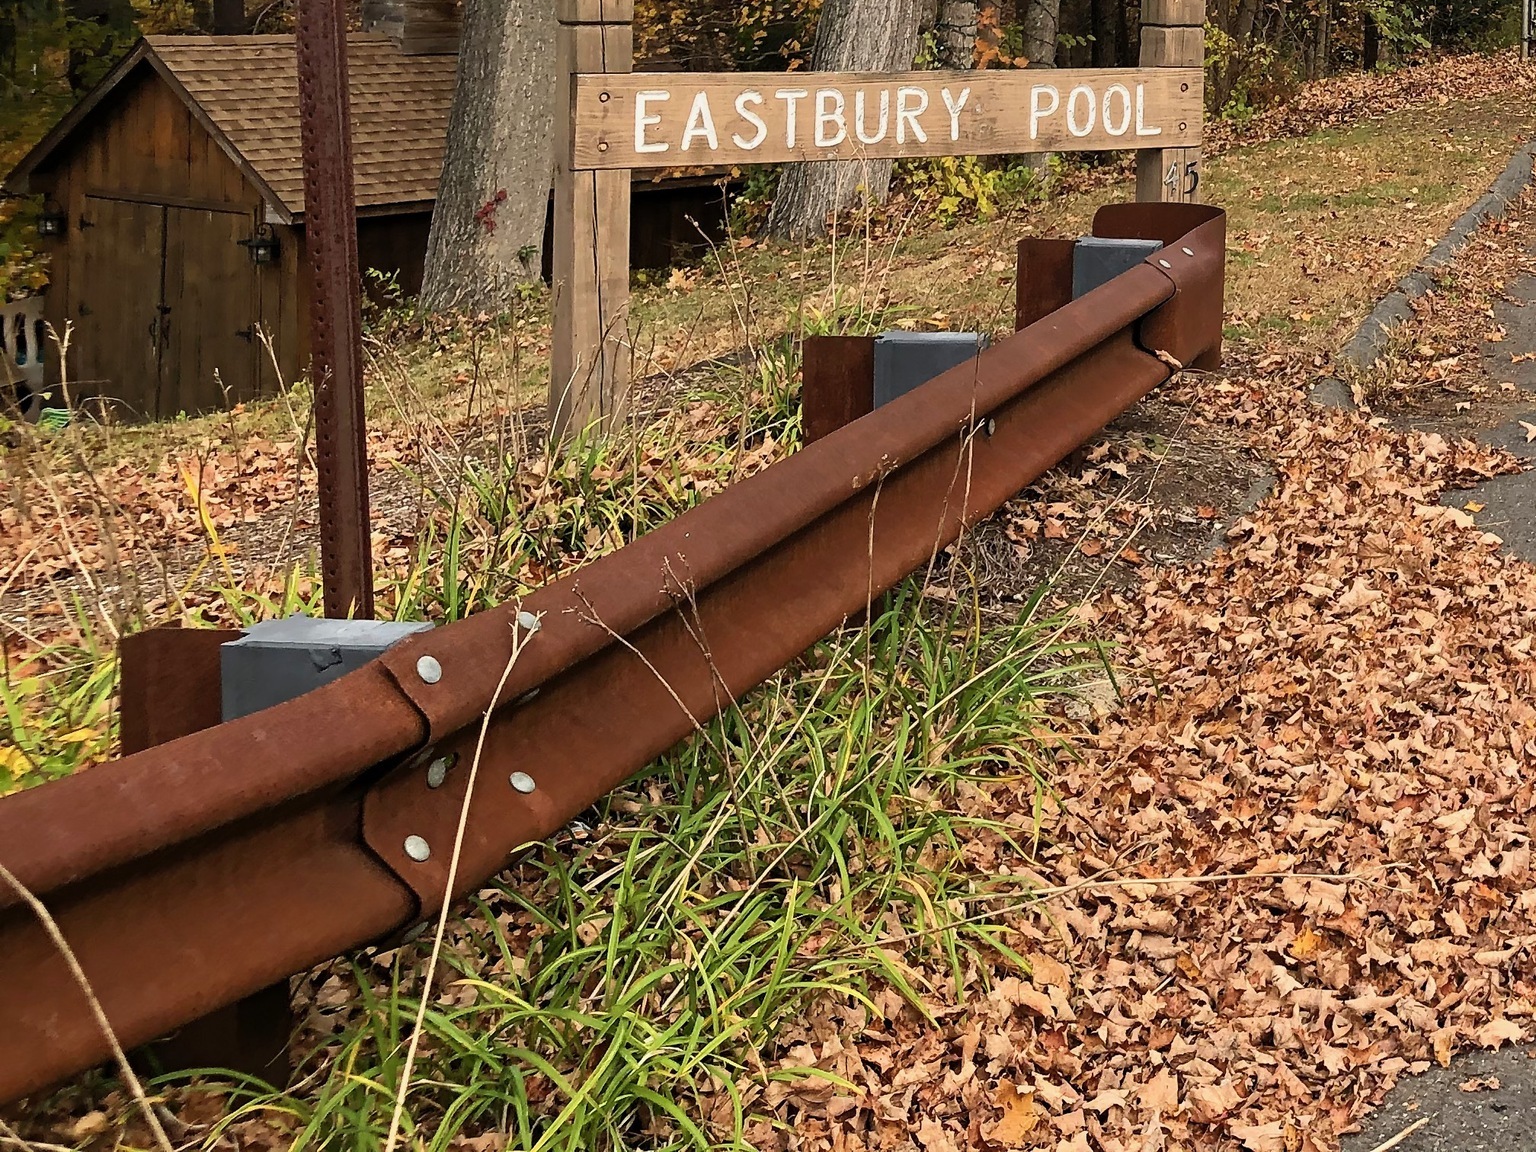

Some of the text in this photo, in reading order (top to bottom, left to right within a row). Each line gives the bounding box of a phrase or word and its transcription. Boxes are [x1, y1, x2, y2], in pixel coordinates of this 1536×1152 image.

[635, 82, 1162, 152] EASTBURY POOL
[1163, 160, 1199, 195] 45
